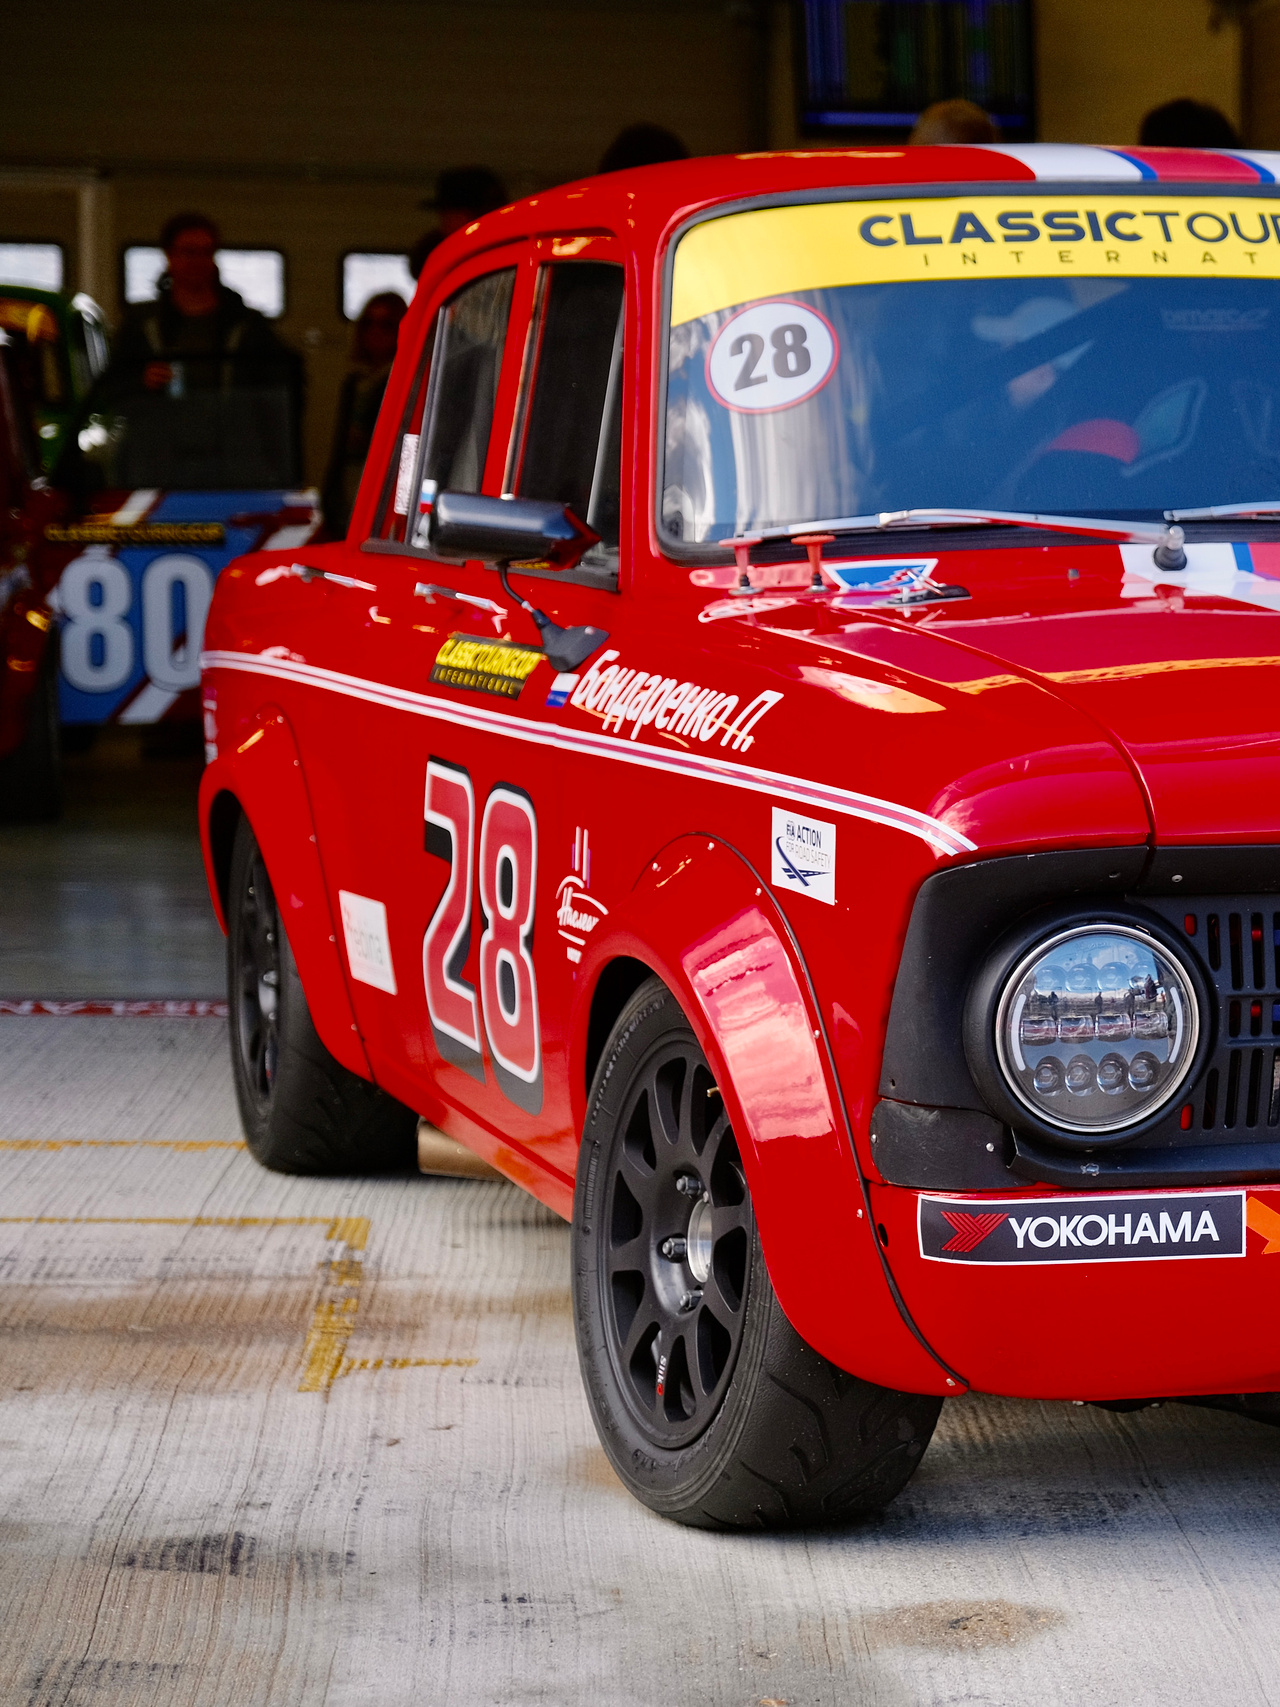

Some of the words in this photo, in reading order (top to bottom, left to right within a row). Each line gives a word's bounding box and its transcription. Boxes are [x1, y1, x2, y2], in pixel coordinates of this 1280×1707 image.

[729, 323, 812, 392] 28
[60, 553, 214, 694] 80
[570, 649, 740, 742] Бондаренко
[786, 822, 796, 838] FIA
[796, 824, 822, 849] ACTION
[423, 757, 542, 1100] 28
[1008, 1210, 1220, 1249] YOKOHAMA
